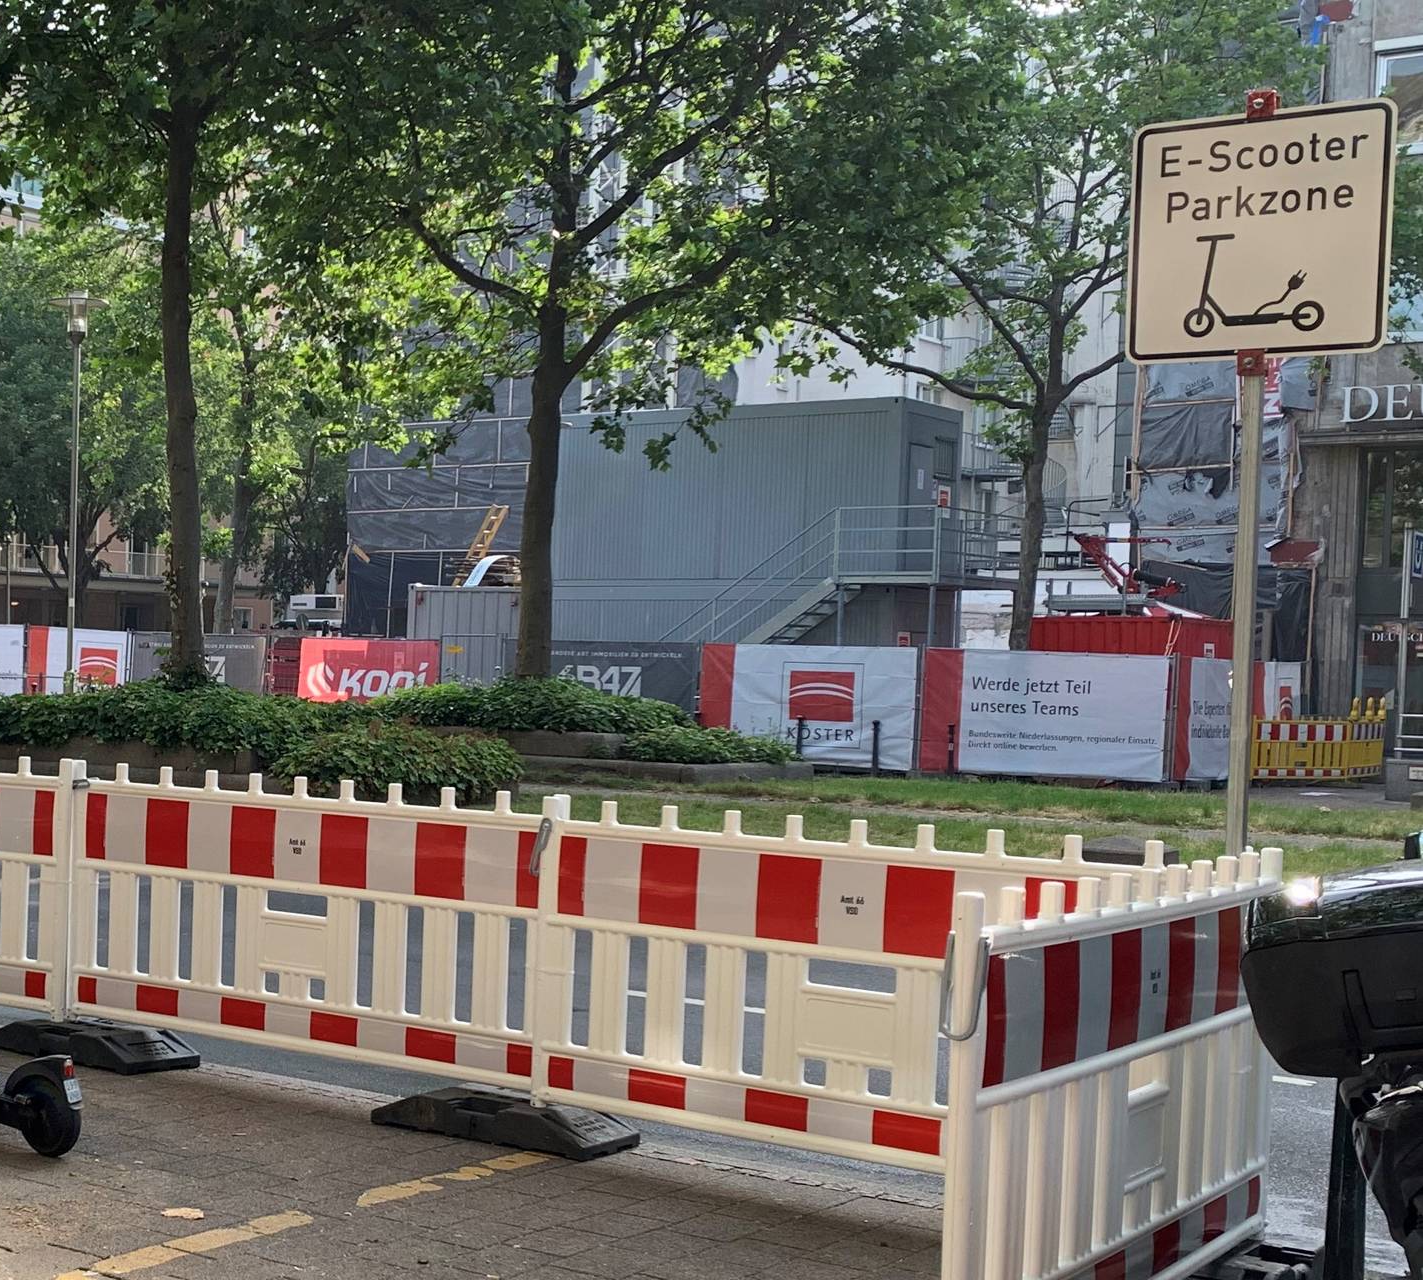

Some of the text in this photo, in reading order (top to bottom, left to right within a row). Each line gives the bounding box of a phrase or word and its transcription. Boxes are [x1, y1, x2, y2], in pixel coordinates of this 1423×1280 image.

[1160, 132, 1369, 178] E-Scooter
[1166, 184, 1354, 223] Parkzone
[972, 676, 1091, 696] Werde jetzt Teil
[971, 701, 1079, 716] unseres Teams
[968, 730, 1158, 745] Bundesweite Niederlassungen, regionaler Einsatz.
[968, 741, 991, 749] Direkt
[993, 742, 1017, 750] online
